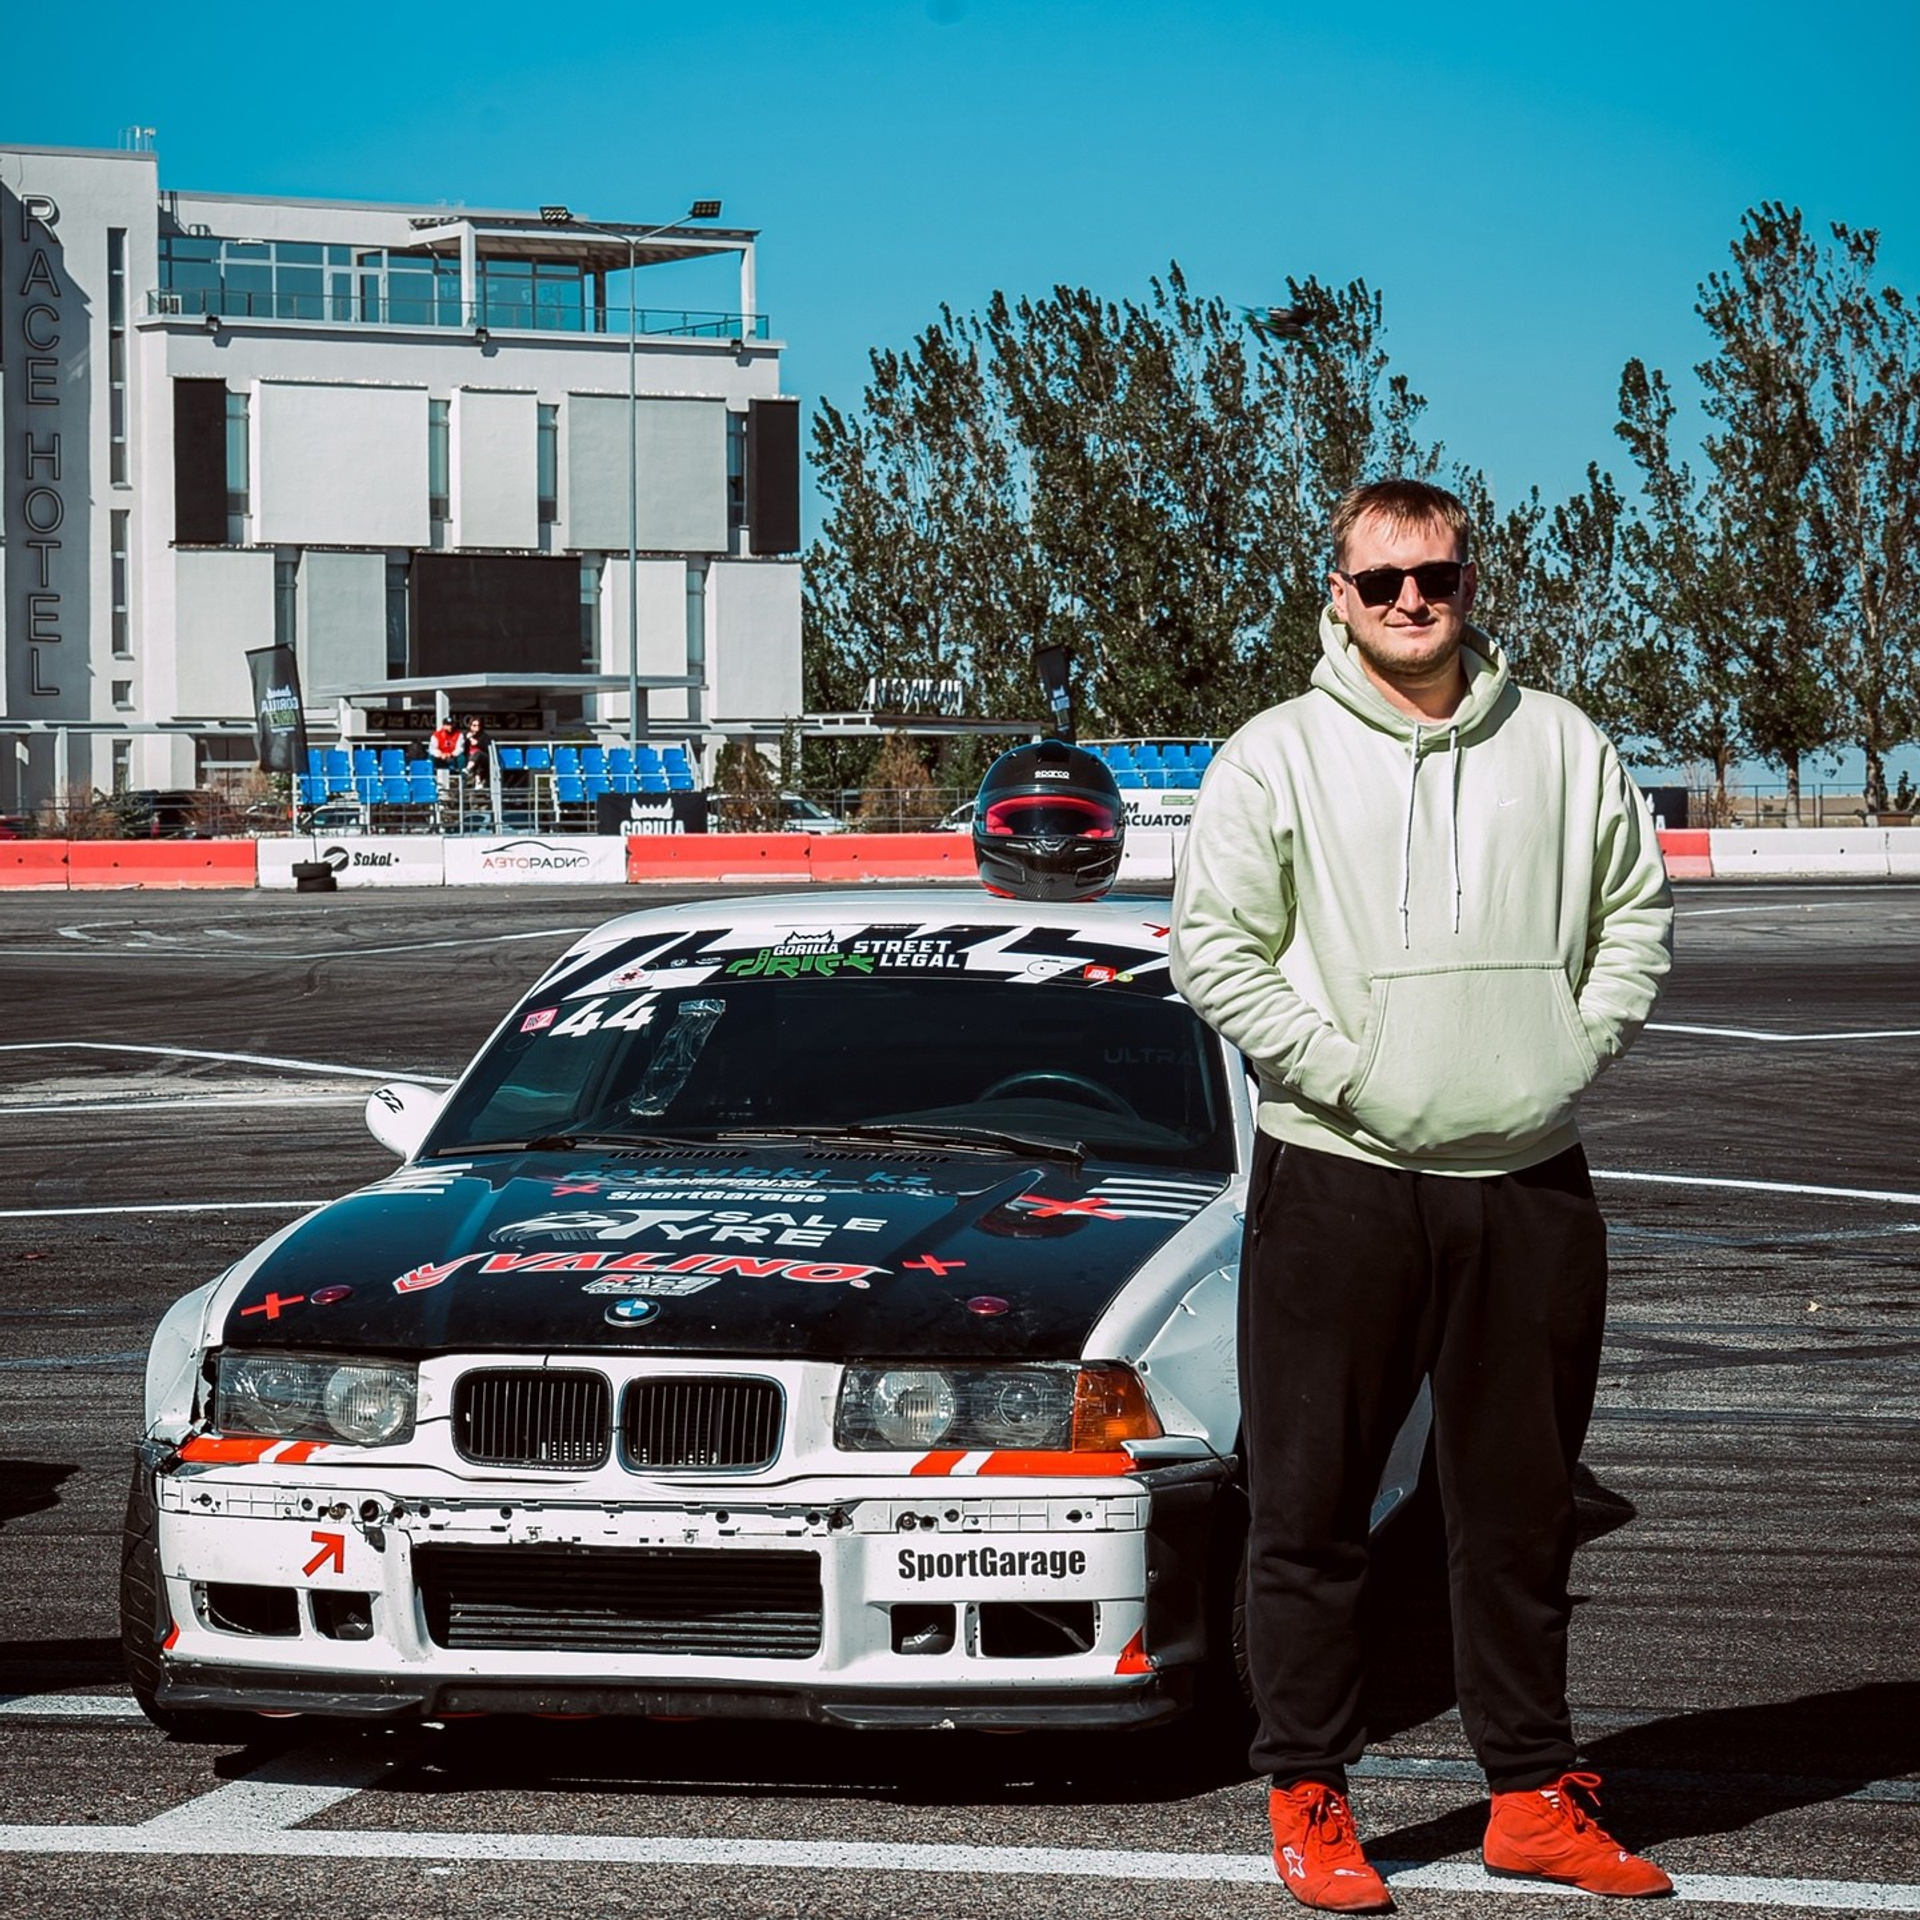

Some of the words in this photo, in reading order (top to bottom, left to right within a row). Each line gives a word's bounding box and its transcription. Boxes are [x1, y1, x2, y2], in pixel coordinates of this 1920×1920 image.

[20, 193, 60, 406] RACE
[22, 432, 64, 697] HOTEL
[619, 820, 685, 836] GORILLA
[1122, 814, 1192, 827] ACUATOR
[773, 942, 839, 956] GORILLA
[852, 940, 952, 954] STREET
[879, 953, 960, 968] LEGAL
[548, 992, 662, 1038] 44
[606, 1189, 828, 1204] SportGarage
[708, 1211, 888, 1232] SALE
[478, 1251, 894, 1283] VALINO
[898, 1547, 1086, 1582] SportGarage
